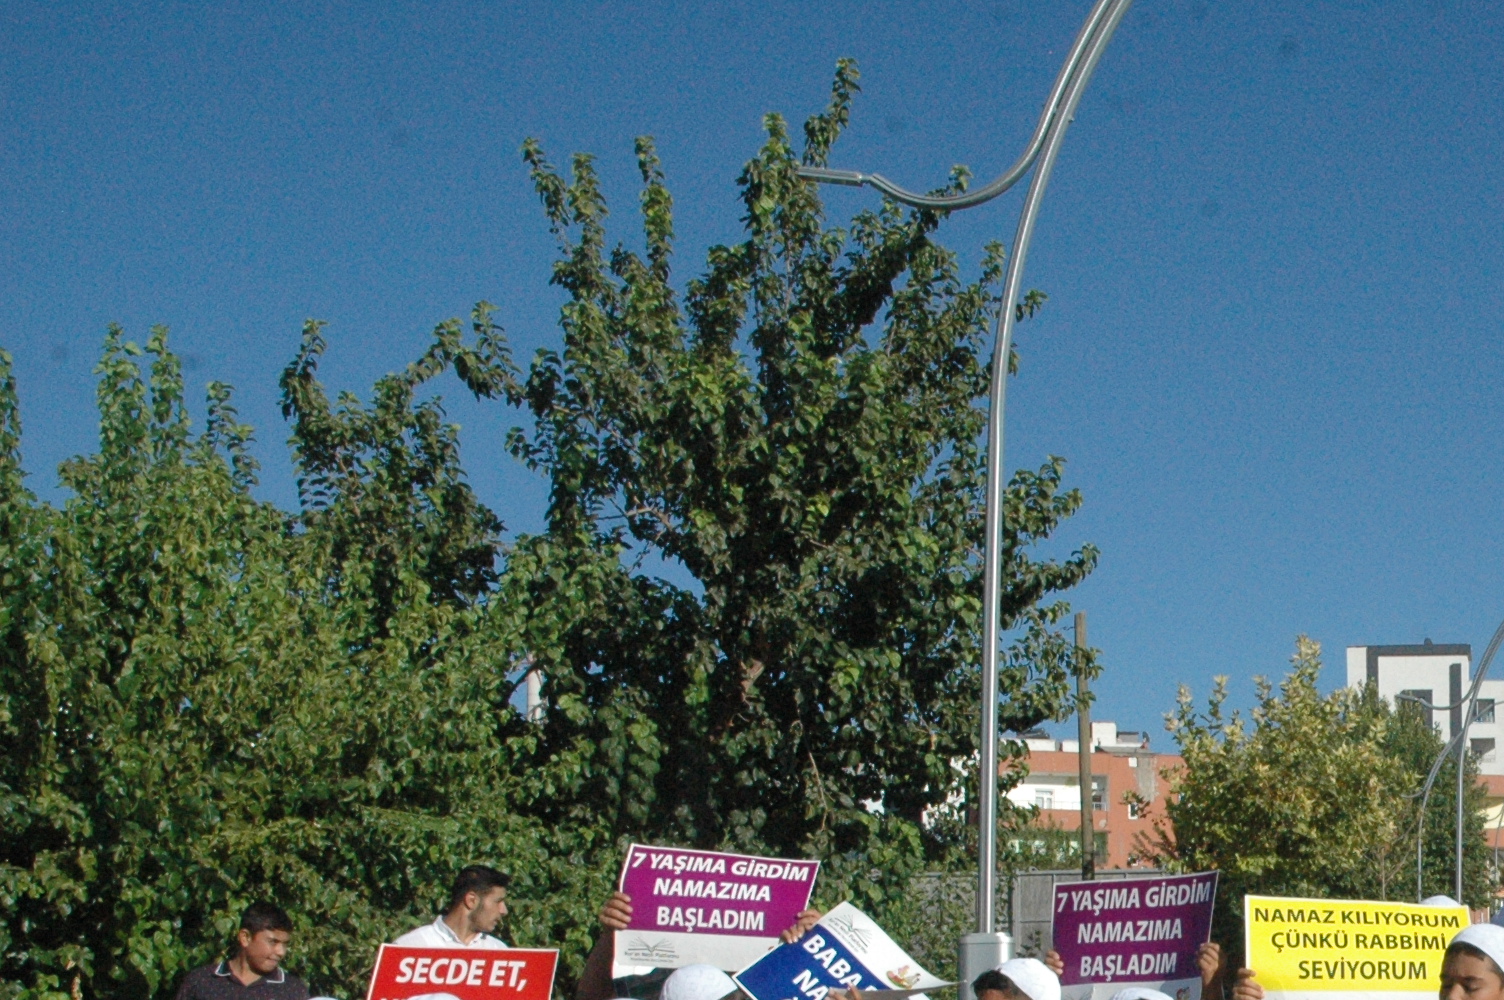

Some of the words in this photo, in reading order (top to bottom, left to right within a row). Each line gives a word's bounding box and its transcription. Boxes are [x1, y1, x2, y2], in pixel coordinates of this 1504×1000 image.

[632, 853, 647, 868] 7
[650, 853, 726, 875] YAŞIMA
[731, 860, 810, 882] GİRDİM
[653, 878, 771, 902] NAMAZIMA
[1057, 892, 1068, 912] 7
[1072, 888, 1140, 915] YAŞIMA
[1146, 879, 1211, 908] GİRDİM
[656, 906, 765, 933] BAŞLADIM
[1078, 918, 1182, 944] NAMAZIMA
[1254, 908, 1335, 924] NAMAZ
[1342, 910, 1460, 928] KILIYORUM
[1271, 929, 1348, 953] ÇÜNKÜ
[1355, 932, 1446, 950] RABBİMİ
[395, 957, 486, 986] SECDE
[488, 960, 527, 991] ET,
[1080, 952, 1177, 981] BAŞLADIM
[1298, 957, 1427, 980] SEVİYORUM
